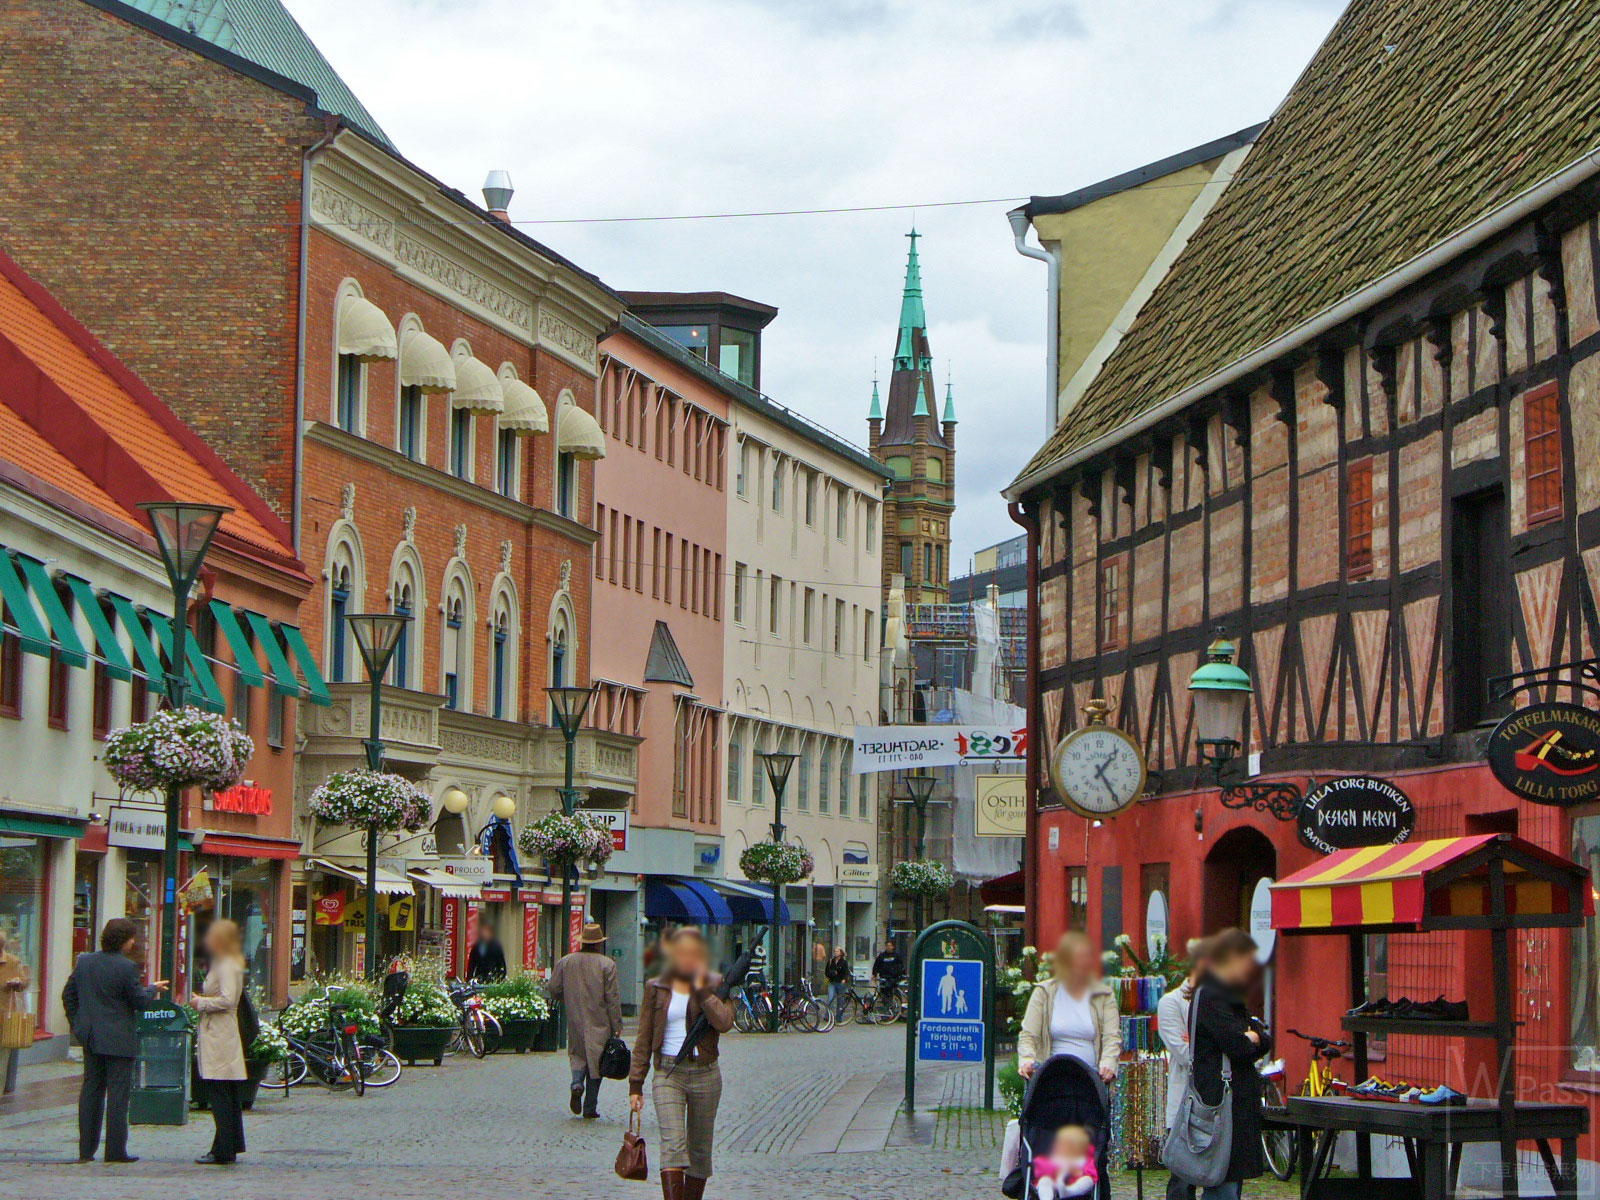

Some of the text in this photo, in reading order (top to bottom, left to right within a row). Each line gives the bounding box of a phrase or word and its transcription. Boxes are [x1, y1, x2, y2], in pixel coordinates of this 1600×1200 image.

[1516, 776, 1598, 799] LILLA TORG
[1305, 778, 1410, 813] LILLA TORG BUTIKEN
[1318, 808, 1397, 828] DESIGN MERVI
[115, 820, 135, 834] FOLK
[146, 824, 166, 838] ROCK
[454, 864, 485, 874] PROLOG
[843, 869, 872, 877] Glitter
[345, 919, 366, 928] TRIS
[445, 903, 454, 936] VIDEO
[144, 1009, 176, 1019] metro
[922, 1023, 980, 1033] Fordonstrafik
[930, 1033, 972, 1042] förbjuden
[941, 1042, 947, 1050] 5
[969, 1043, 978, 1051] 5)
